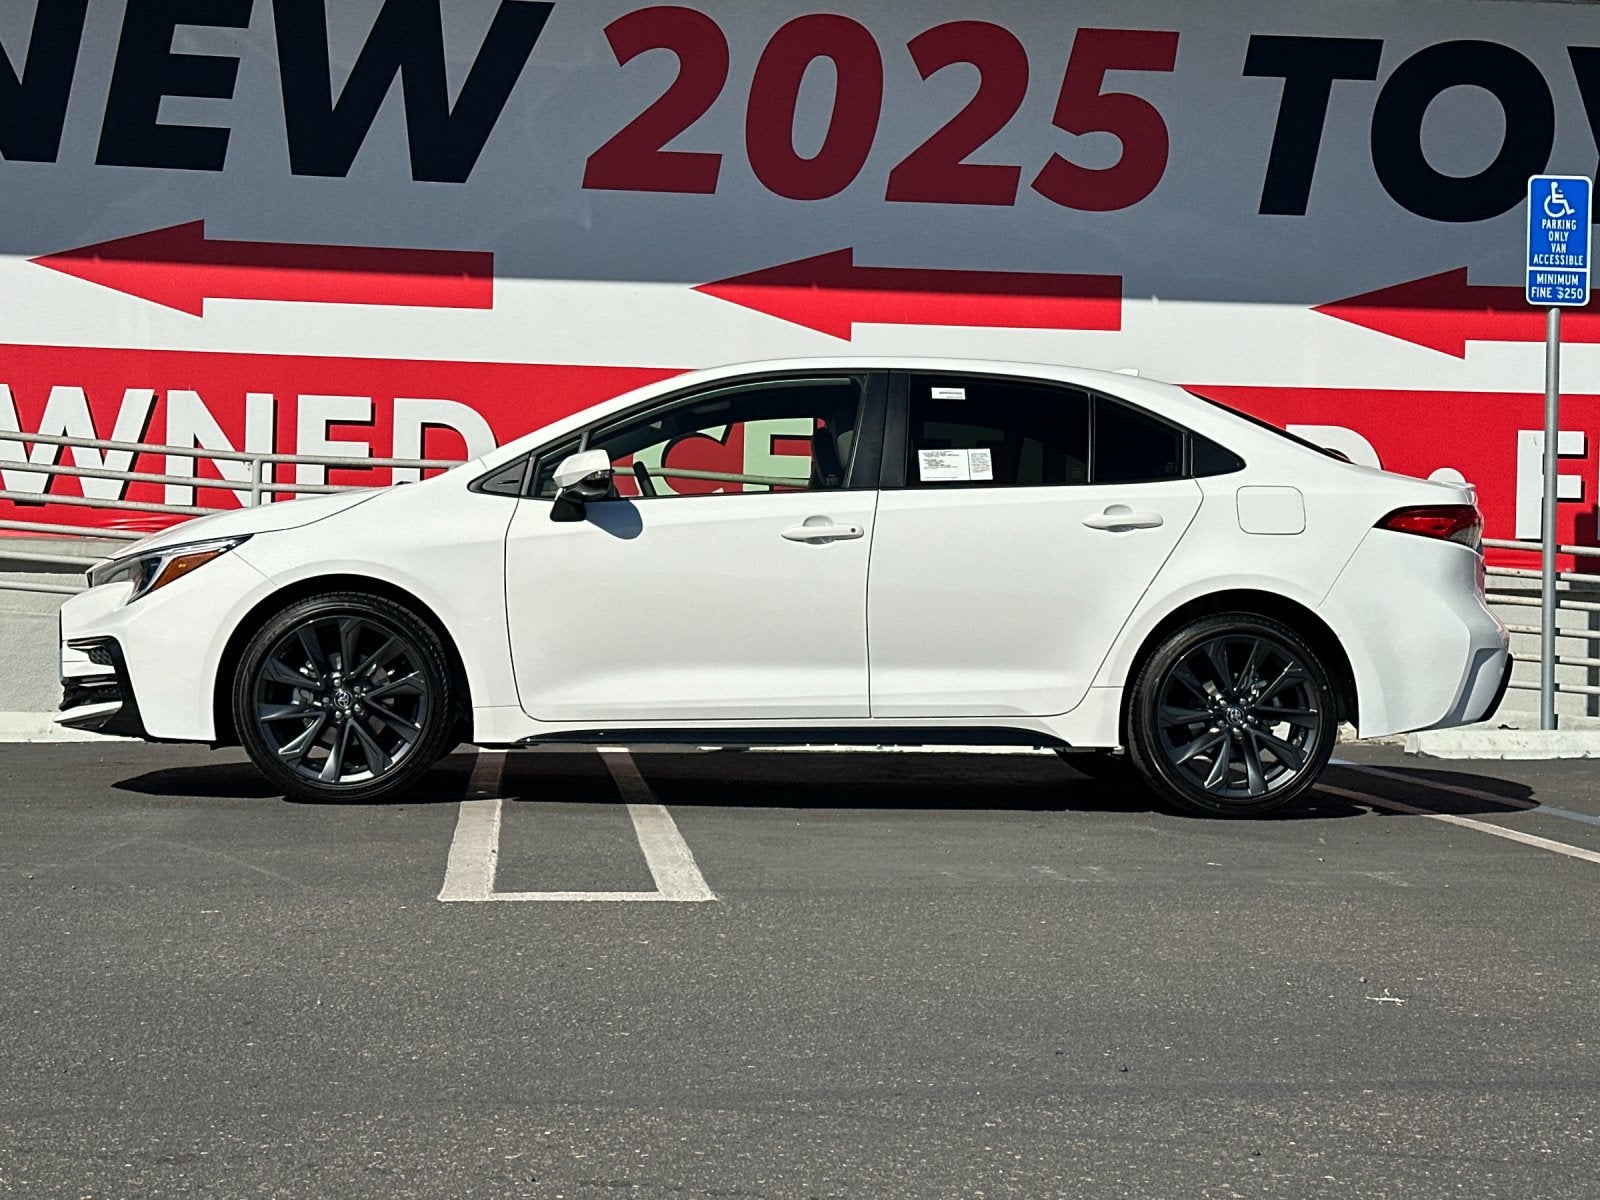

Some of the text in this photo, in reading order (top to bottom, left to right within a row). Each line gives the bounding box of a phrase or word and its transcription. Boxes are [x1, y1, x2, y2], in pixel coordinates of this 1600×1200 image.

[582, 5, 1180, 211] 2025
[1242, 35, 1600, 224] TO
[1541, 219, 1577, 230] PARKING
[1548, 231, 1569, 242] ONLY
[1551, 243, 1567, 254] VAN
[1533, 254, 1584, 266] ACCESSIBLE
[1536, 273, 1579, 286] MINIMUM
[1531, 286, 1584, 299] FINE $250
